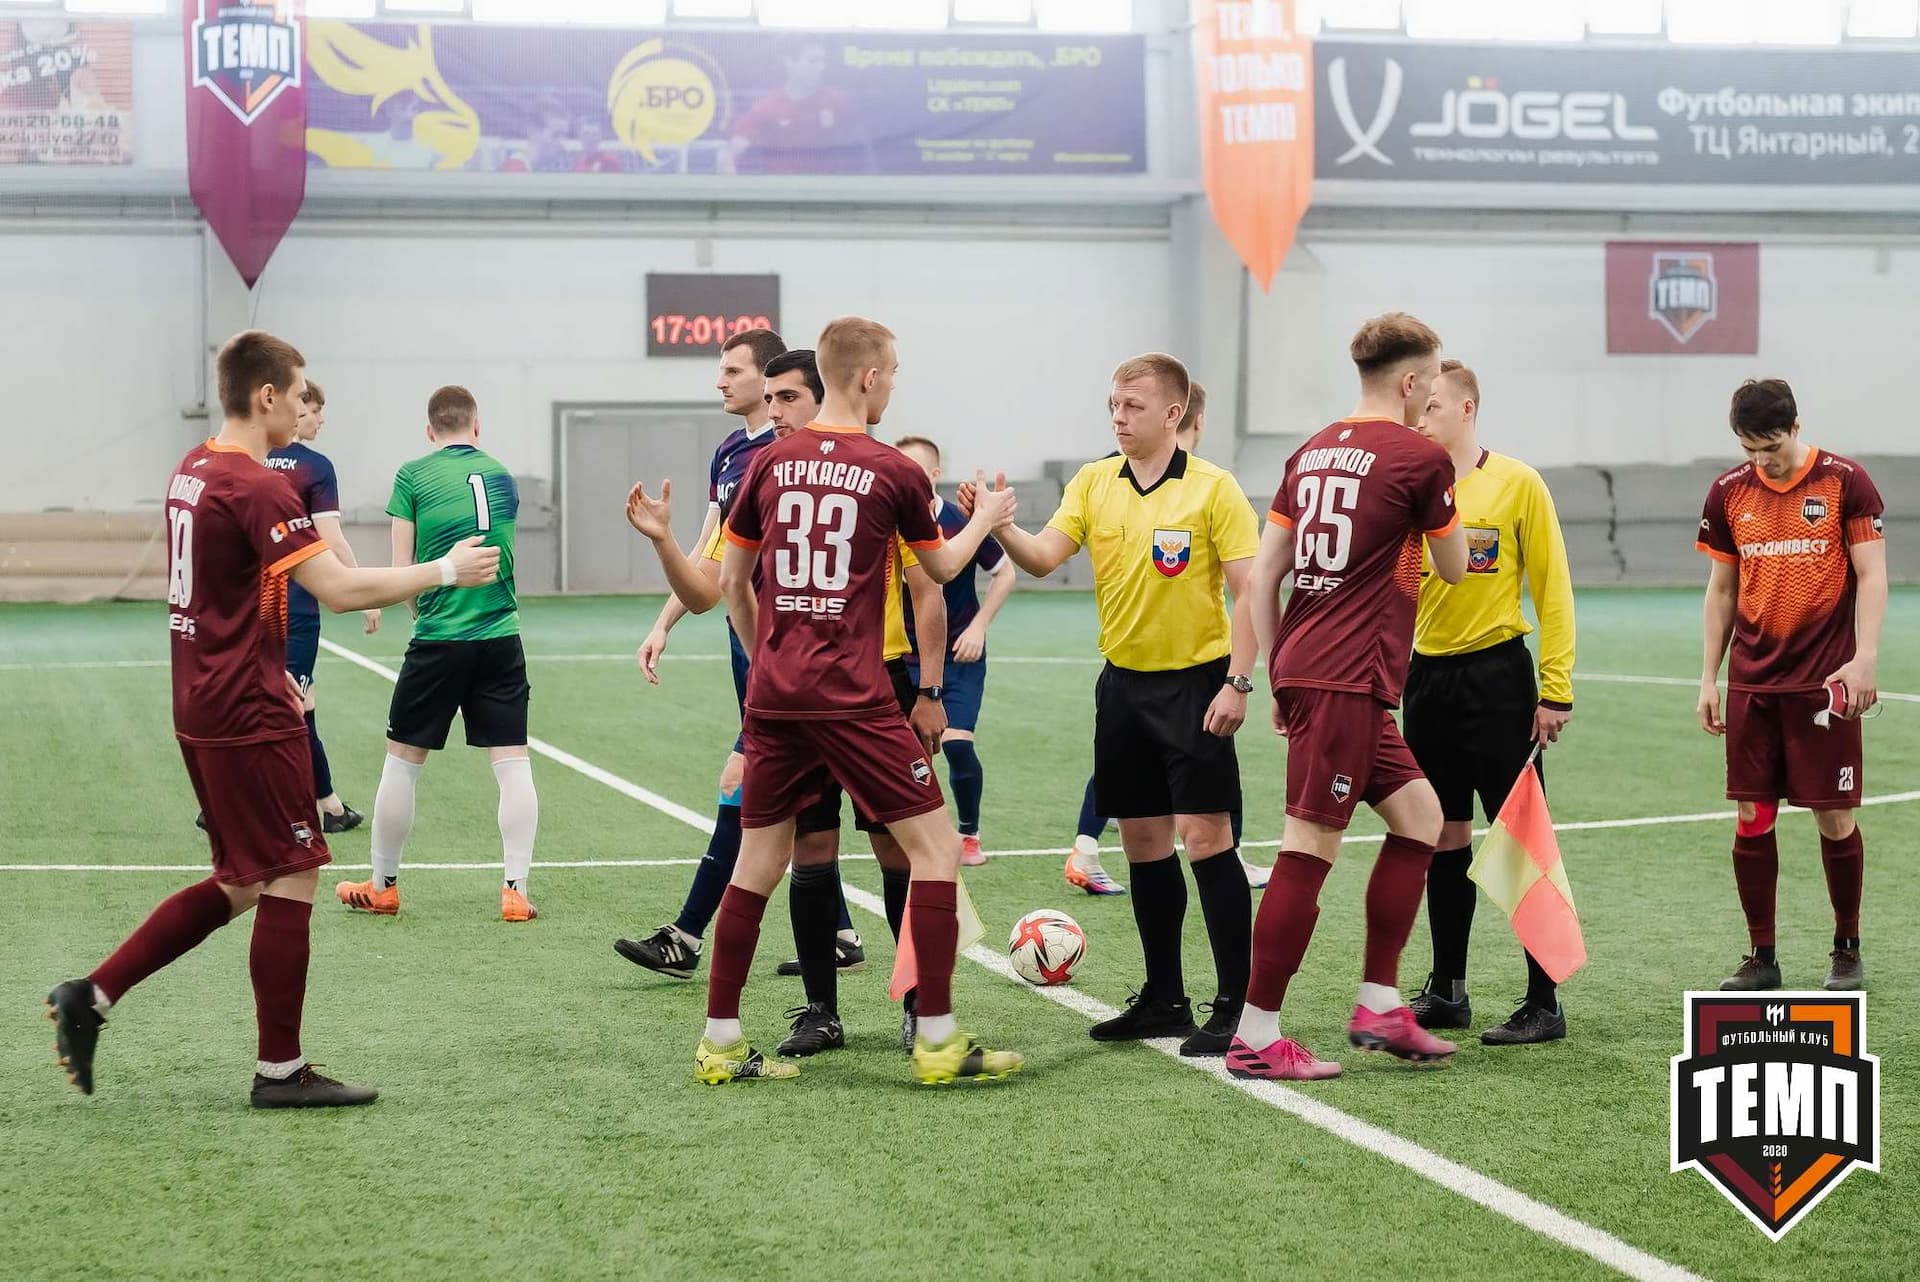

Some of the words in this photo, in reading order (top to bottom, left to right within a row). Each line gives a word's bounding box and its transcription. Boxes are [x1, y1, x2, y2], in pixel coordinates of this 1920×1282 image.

[203, 23, 290, 72] ТЕМП
[638, 85, 704, 109] .БРО
[1409, 75, 1659, 140] JÖGEL
[1657, 86, 1845, 121] Футбольная
[1688, 125, 1731, 160] ТЦ
[1738, 125, 1894, 160] Янтарный,
[1657, 277, 1709, 310] ТЕМП
[773, 461, 875, 495] ЧЕРКАСОВ
[1297, 447, 1376, 476] НОВИЧКОВ
[466, 473, 491, 531] 1
[1295, 475, 1360, 571] 25
[775, 491, 858, 591] 33
[775, 595, 847, 613] SEUS
[1838, 766, 1854, 791] 23
